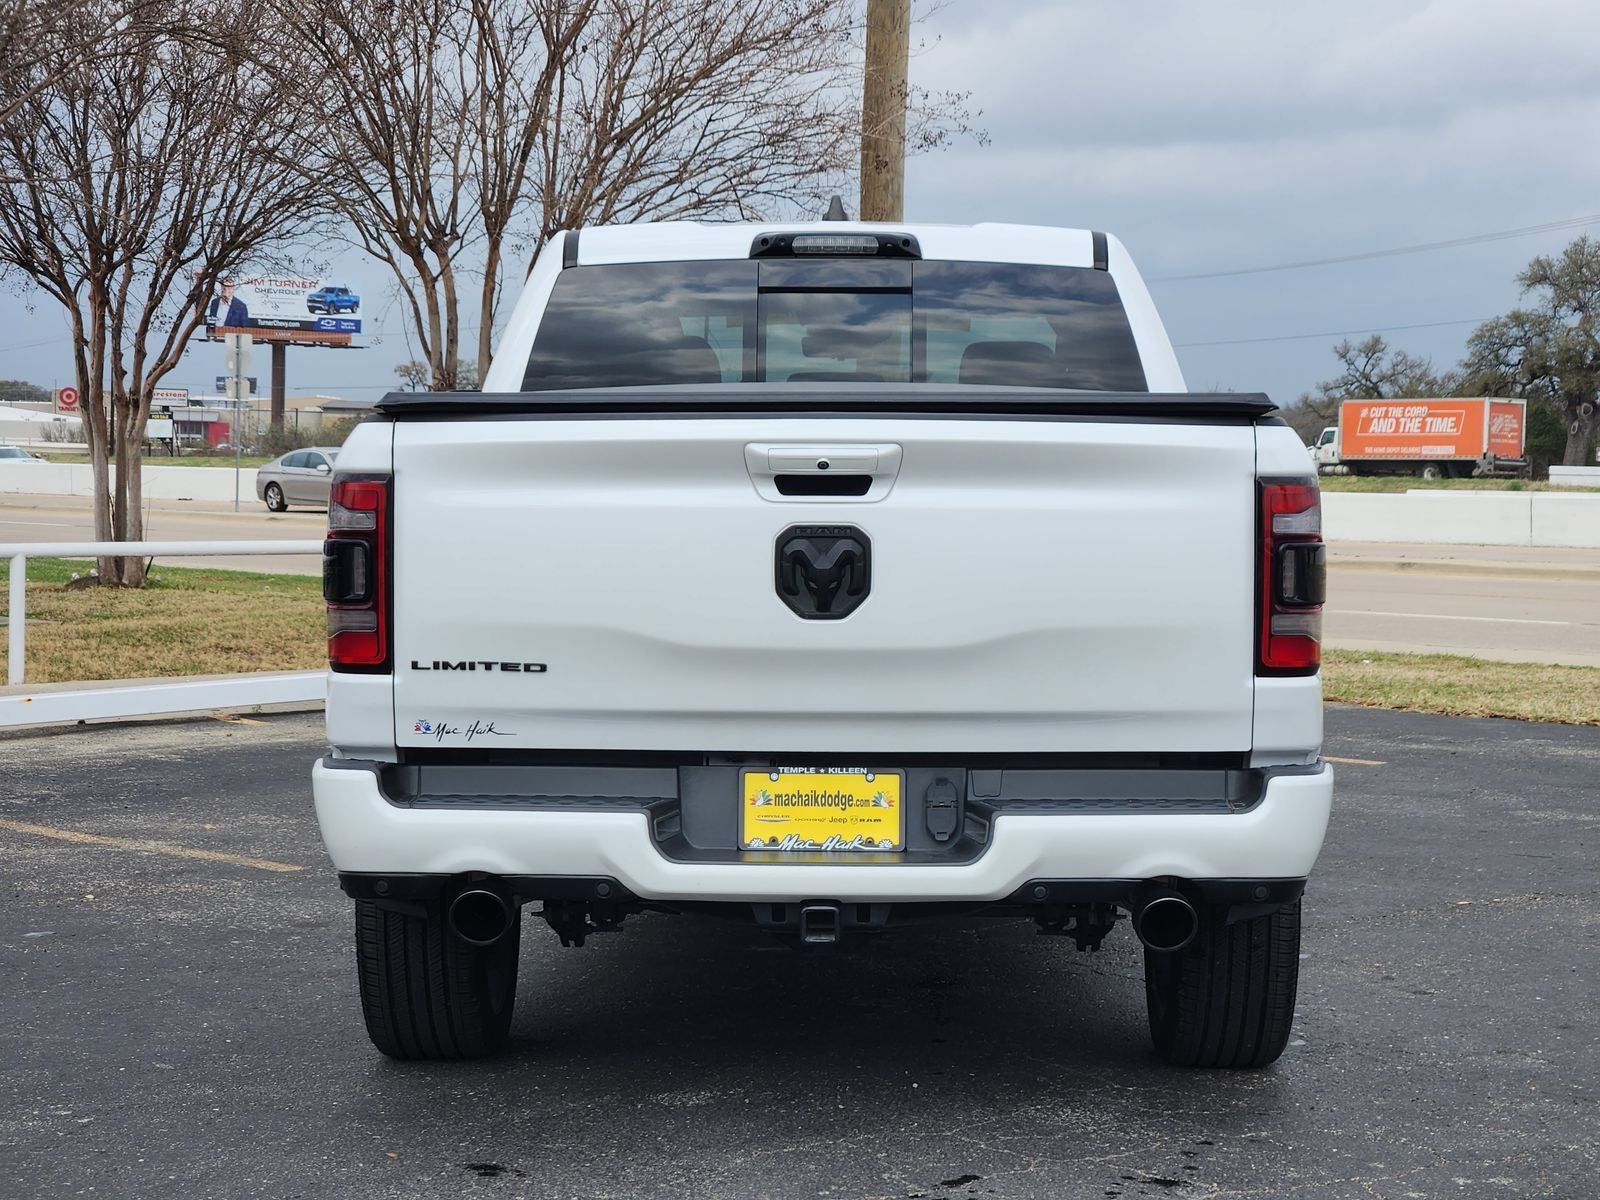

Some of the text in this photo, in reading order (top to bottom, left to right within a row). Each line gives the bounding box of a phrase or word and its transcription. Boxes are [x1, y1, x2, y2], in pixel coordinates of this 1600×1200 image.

[268, 279, 317, 289] TURNER
[254, 287, 306, 296] CHEVROLET
[257, 319, 301, 328] TurnerChevy.com
[1370, 406, 1387, 418] CUT
[1388, 406, 1404, 418] THE
[1405, 406, 1428, 418] CORD
[1369, 417, 1458, 433] AND THE TIME.
[795, 527, 852, 535] RAM
[411, 660, 548, 673] LIMITED
[433, 720, 512, 742] Mac Haik
[778, 766, 816, 774] TEMPLE
[774, 790, 870, 811] machaikdodge.com
[829, 816, 848, 824] Jeep
[778, 833, 866, 851] Mac Haik
